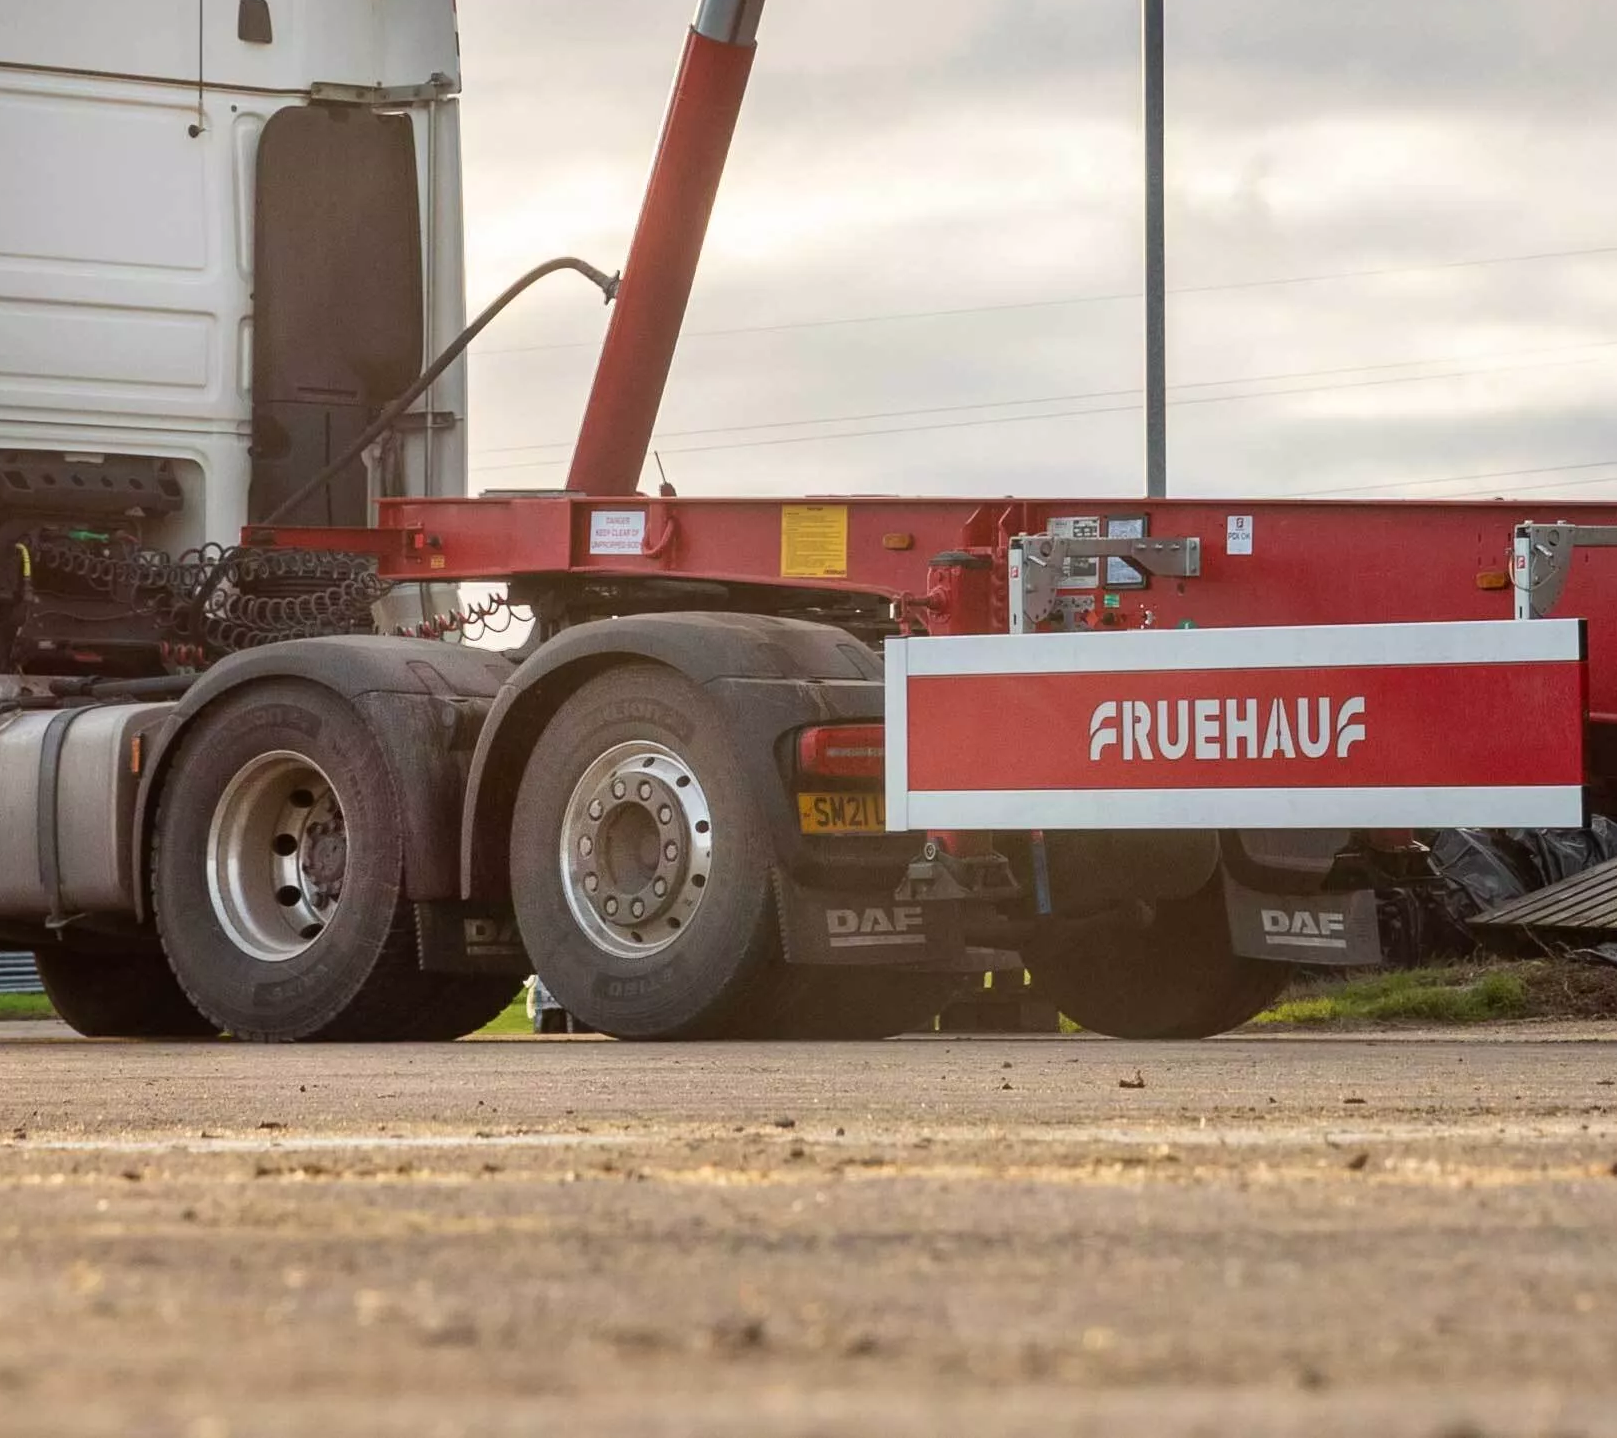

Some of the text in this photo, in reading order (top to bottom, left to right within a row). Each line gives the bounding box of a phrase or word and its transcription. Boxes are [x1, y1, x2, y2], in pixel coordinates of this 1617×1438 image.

[1089, 696, 1366, 761] FRUEHAUF
[814, 796, 869, 827] SM21
[826, 906, 924, 934] DAF
[1261, 910, 1345, 936] DAF
